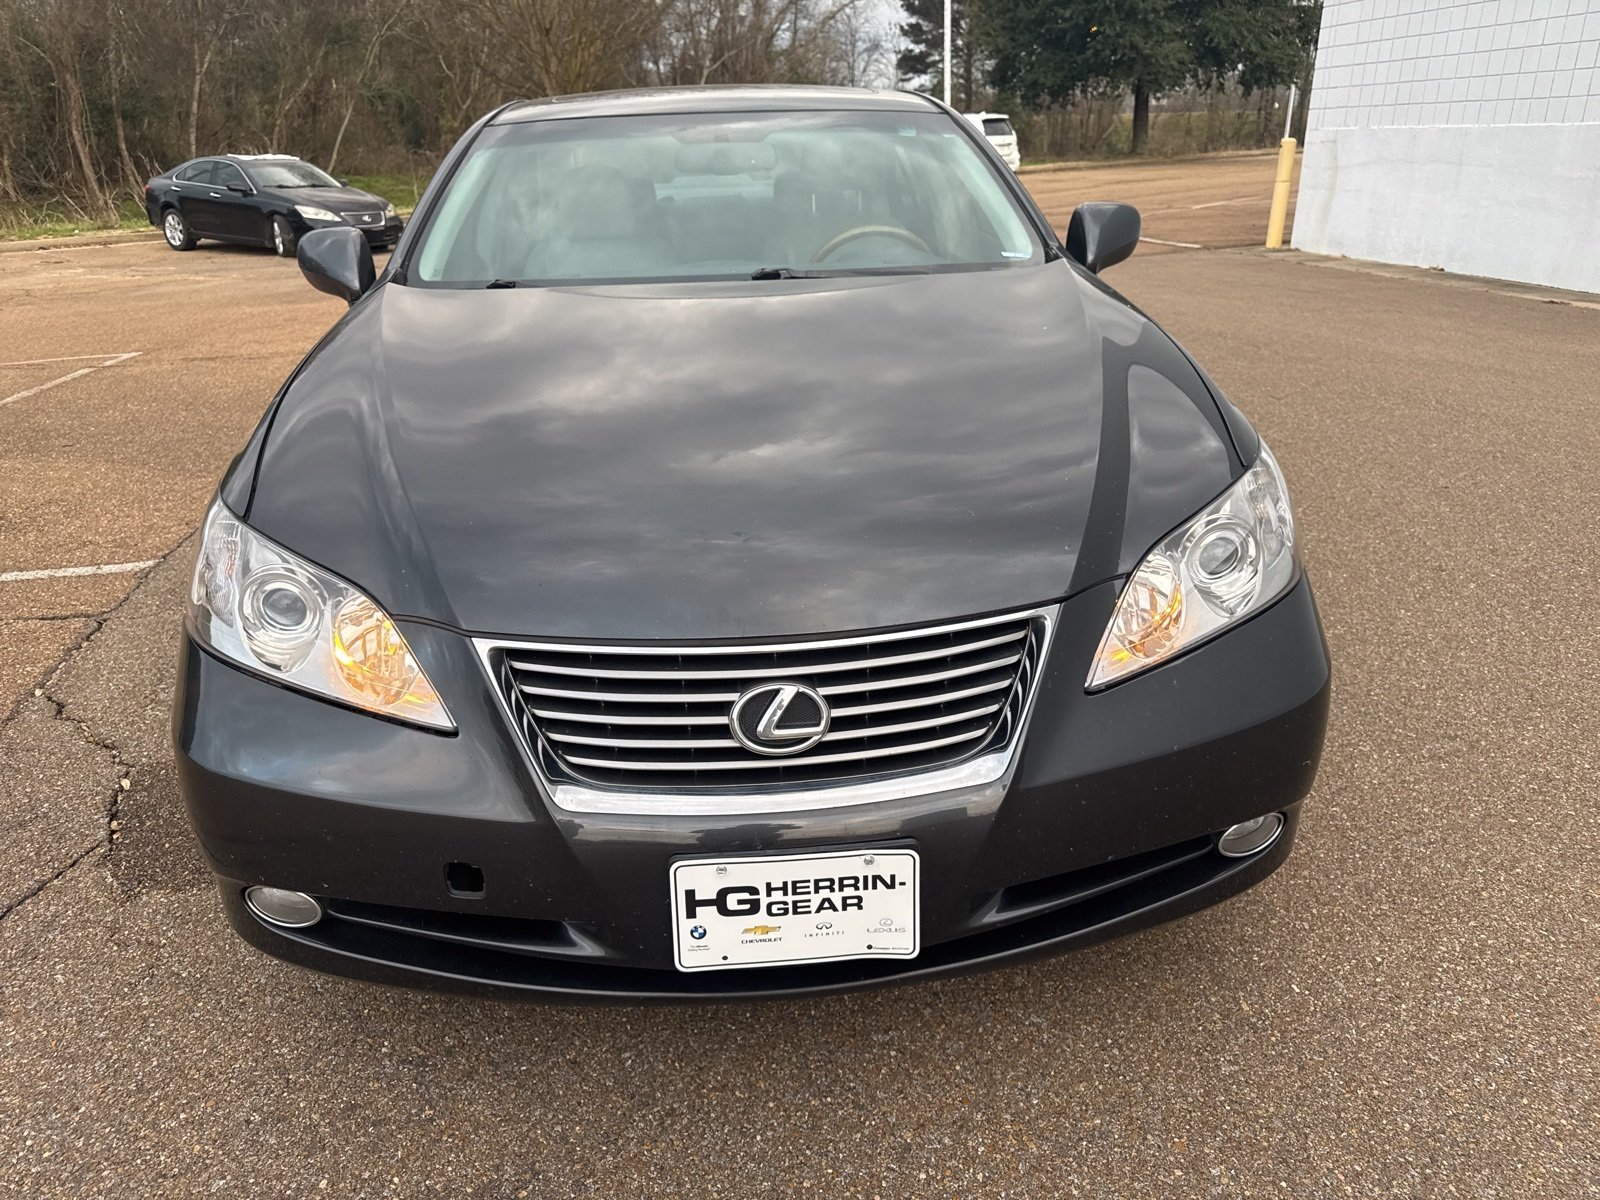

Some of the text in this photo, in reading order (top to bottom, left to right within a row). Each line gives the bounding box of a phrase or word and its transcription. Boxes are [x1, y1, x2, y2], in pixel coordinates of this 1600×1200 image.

[765, 874, 907, 898] HERRIN-
[684, 885, 761, 919] HG
[765, 895, 864, 917] GEAR
